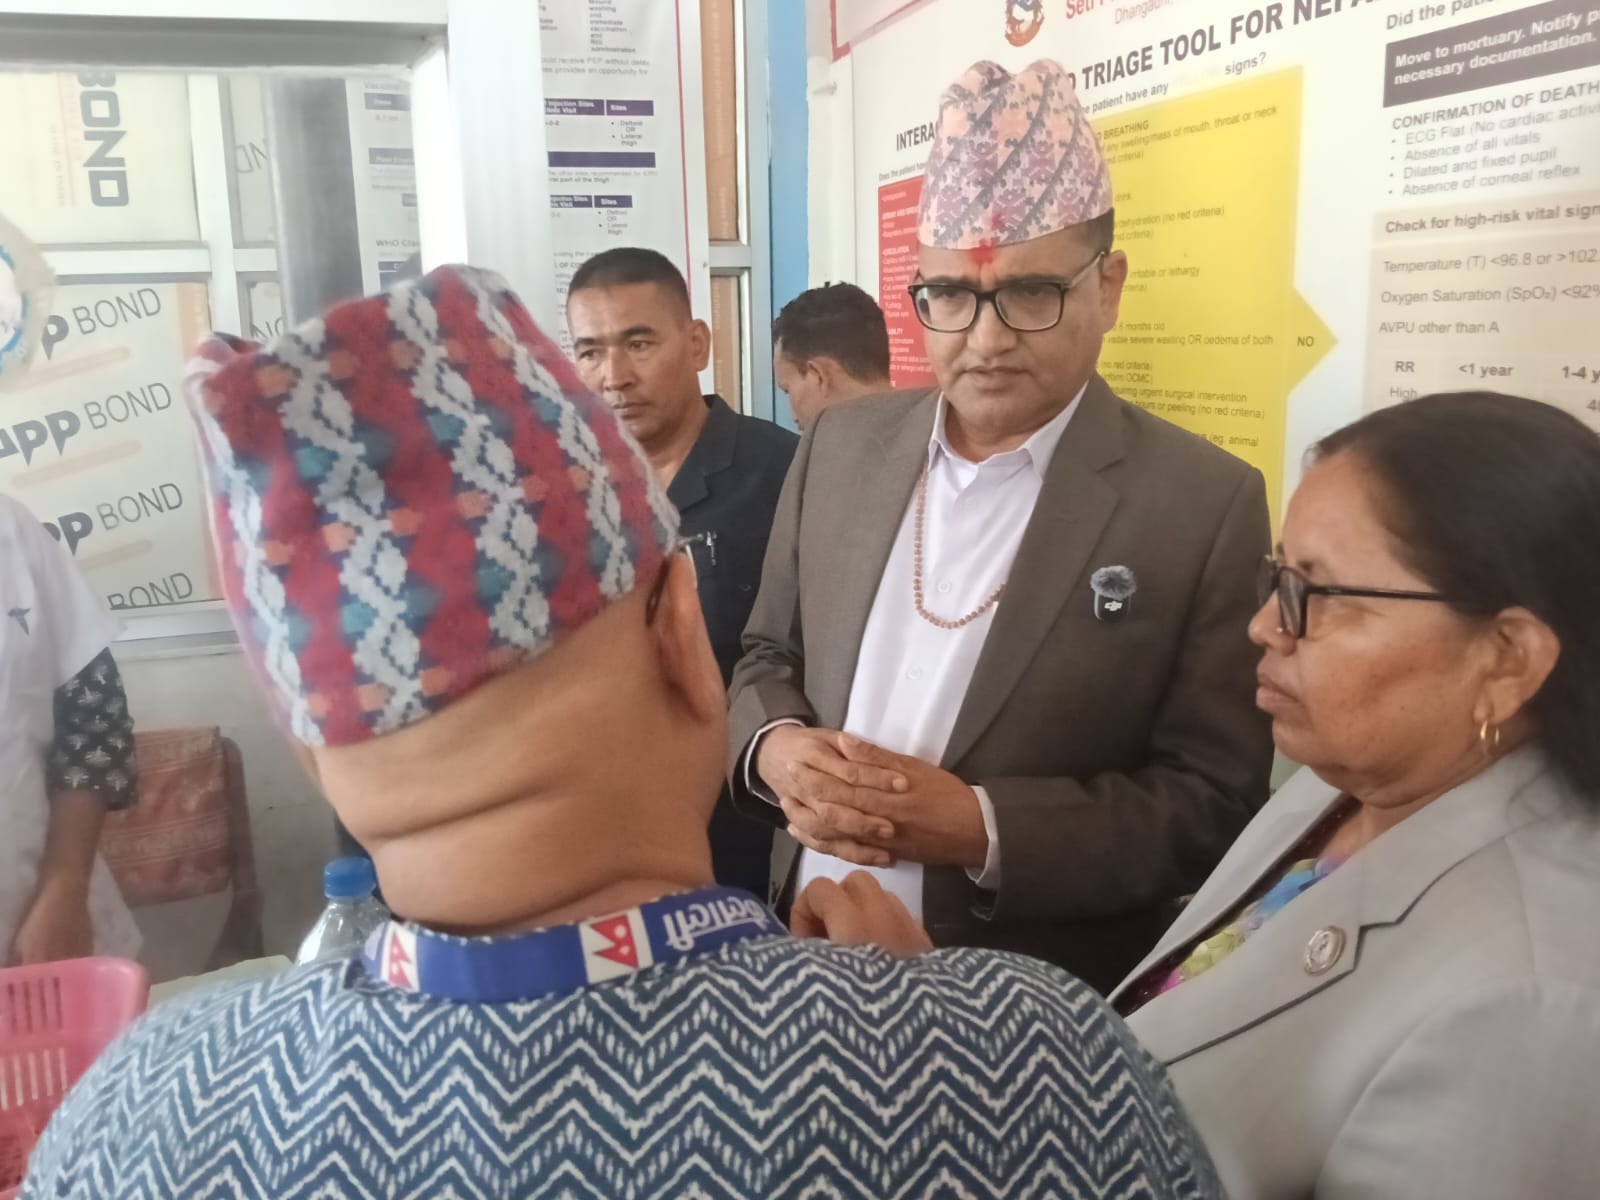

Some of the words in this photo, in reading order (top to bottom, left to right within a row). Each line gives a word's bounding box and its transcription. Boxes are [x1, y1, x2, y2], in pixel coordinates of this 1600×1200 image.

[1386, 11, 1413, 30] Did
[1419, 3, 1446, 21] the
[1082, 45, 1153, 90] TRIAGE
[1160, 25, 1221, 65] TOOL
[1230, 2, 1283, 45] FOR
[1395, 51, 1432, 68] Move
[1435, 46, 1449, 59] to
[1453, 28, 1526, 54] mortuary.
[1531, 12, 1583, 35] Notify
[1394, 61, 1465, 86] necessary
[1469, 30, 1597, 69] documentation.
[1092, 93, 1123, 113] patient
[1125, 87, 1148, 103] have
[1151, 82, 1169, 96] any
[1224, 51, 1267, 76] signs?
[1392, 98, 1507, 130] CONFIRMATION
[1511, 92, 1534, 109] OF
[1540, 80, 1600, 104] DEATH
[1103, 120, 1149, 140] BREATHING
[1214, 112, 1240, 129] throat
[1242, 112, 1252, 122] or
[1405, 129, 1436, 145] ECG
[1441, 124, 1465, 138] Flat
[1470, 121, 1495, 137] (No
[1499, 109, 1554, 129] cardiac
[896, 120, 938, 152] INTERA
[1404, 143, 1461, 161] Absence
[1465, 140, 1479, 153] of
[1482, 135, 1498, 150] all
[1503, 131, 1541, 147] vitals
[1403, 162, 1448, 180] Dilated
[1451, 157, 1478, 172] and
[1482, 152, 1516, 168] fixed
[1520, 147, 1557, 165] pupil
[1402, 178, 1459, 196] Absence
[1462, 175, 1476, 189] of
[1480, 169, 1533, 187] corneal
[1538, 164, 1580, 179] reflex
[1177, 209, 1191, 220] red
[1192, 205, 1225, 219] criteria)
[1385, 219, 1427, 234] Check
[1431, 216, 1451, 230] for
[1454, 209, 1521, 229] high-risk
[1526, 205, 1560, 221] vital
[1384, 257, 1462, 274] Temperature
[1466, 255, 1486, 271] (T)
[1490, 252, 1532, 266] <96.8
[1535, 253, 1552, 264] or
[72, 287, 162, 335] BOND
[1381, 290, 1429, 306] Oxygen
[1432, 288, 1502, 303] Saturation
[1187, 334, 1202, 344] OR
[1204, 334, 1239, 345] oedema
[1241, 334, 1251, 345] of
[1252, 334, 1274, 345] both
[1297, 336, 1315, 347] NO
[1379, 322, 1415, 334] AVPU
[1418, 321, 1452, 334] other
[1455, 321, 1486, 333] than
[1487, 322, 1500, 333] A
[1395, 361, 1415, 373] RR
[1458, 363, 1475, 375] <1
[1480, 365, 1514, 379] year
[1562, 366, 1587, 379] 1-4
[84, 382, 172, 430] BOND
[1165, 389, 1195, 401] surgical
[1197, 391, 1247, 402] intervention
[1390, 386, 1417, 402] High
[1167, 403, 1196, 416] peeling
[1214, 406, 1228, 416] red
[1230, 407, 1265, 420] criteria)
[1228, 436, 1259, 447] animal
[96, 482, 183, 531] BOND
